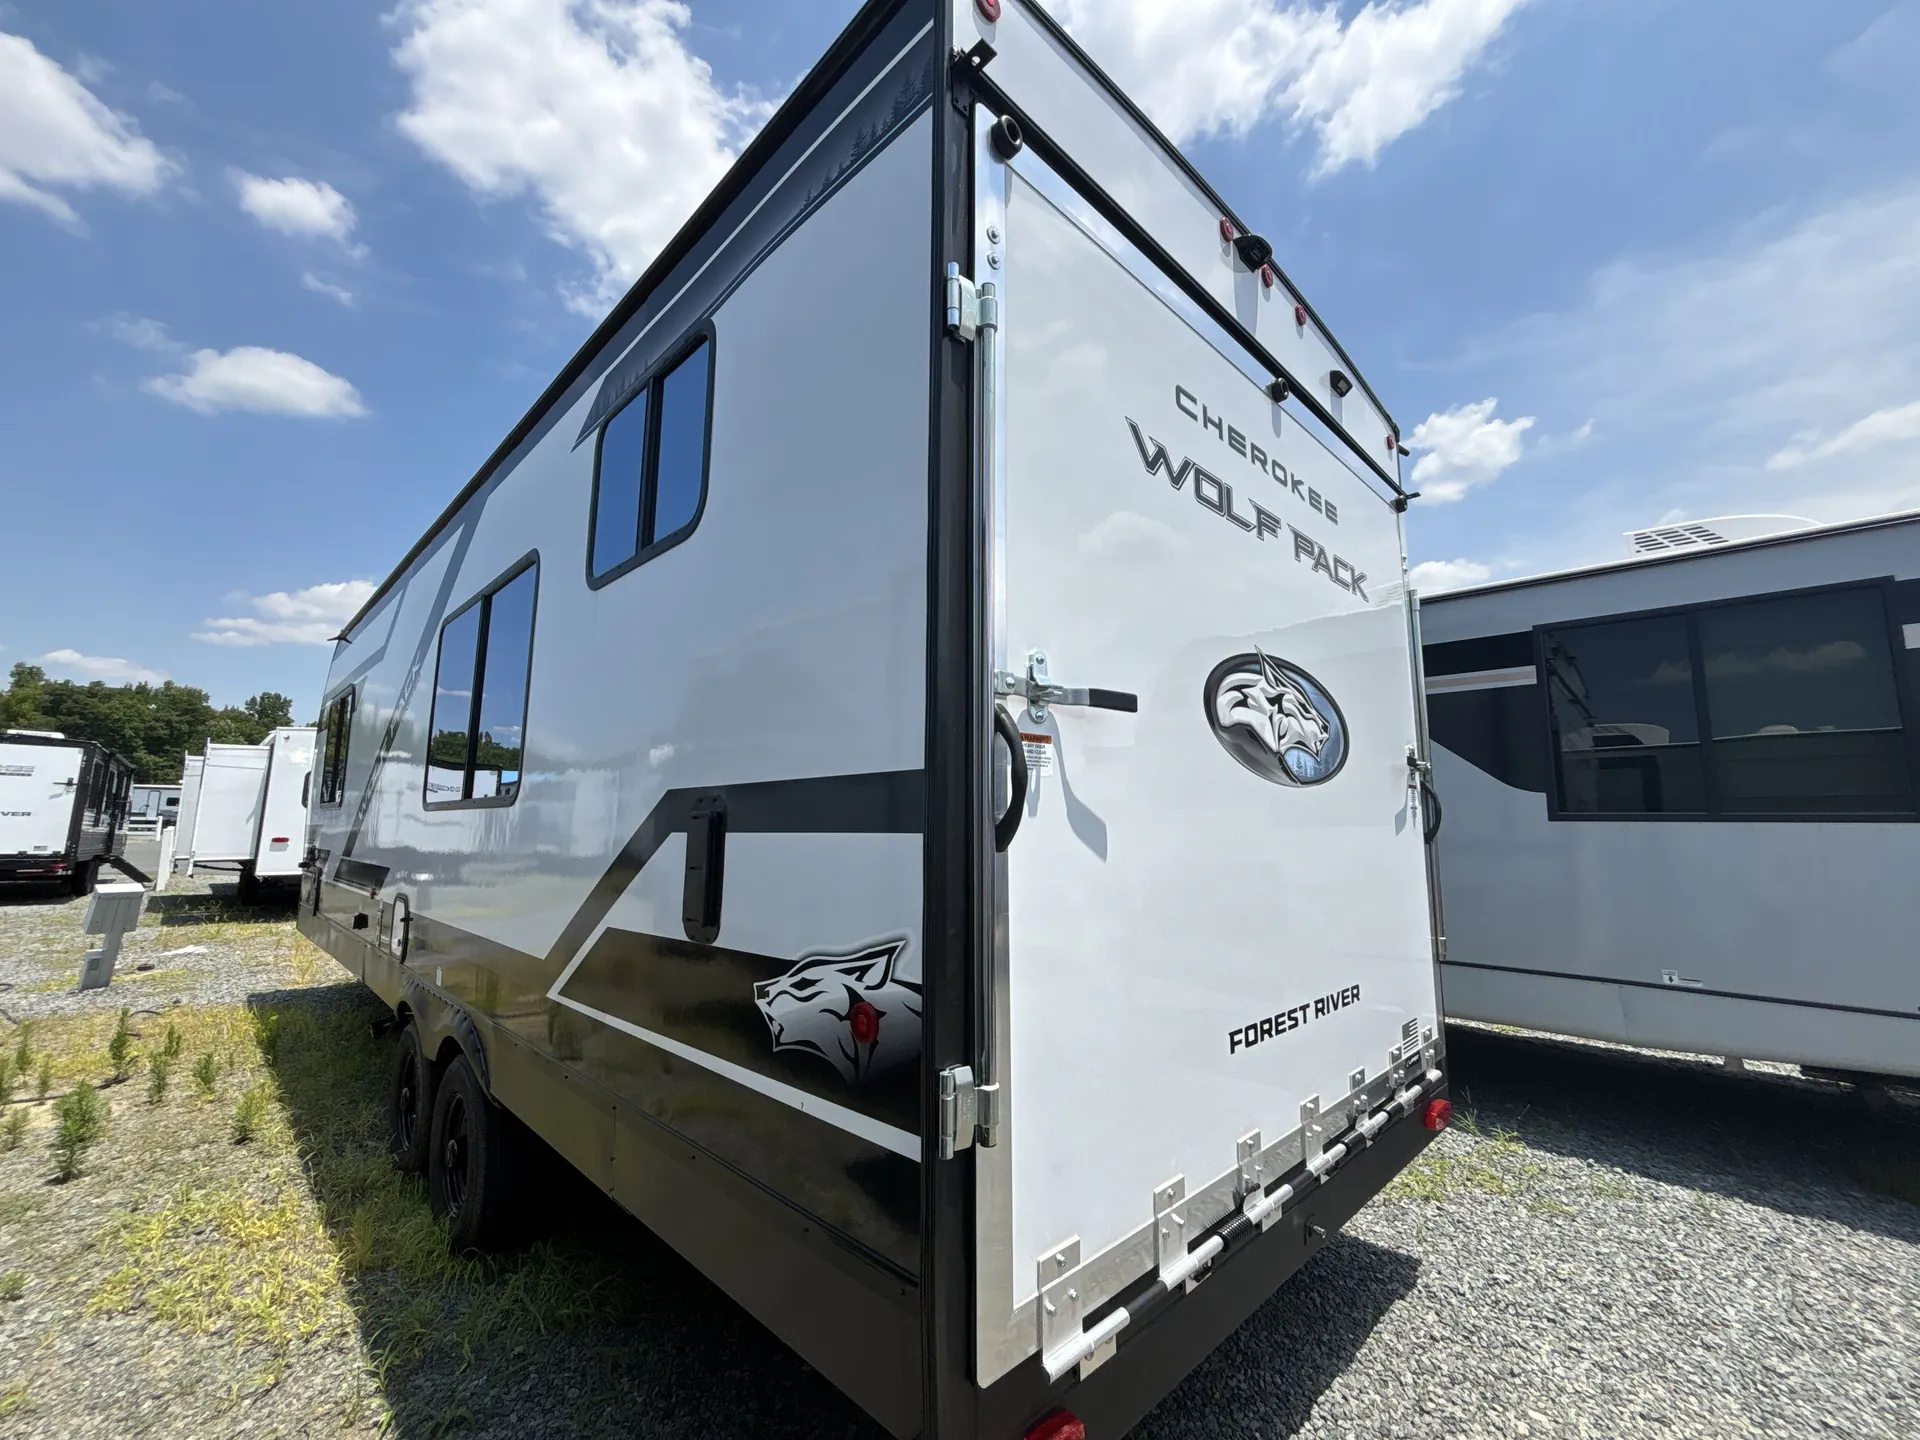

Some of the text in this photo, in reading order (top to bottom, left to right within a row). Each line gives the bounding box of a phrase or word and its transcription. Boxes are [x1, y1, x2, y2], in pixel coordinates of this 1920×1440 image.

[1124, 415, 1369, 602] WOLF PACK
[1175, 384, 1338, 526] CHEROKEE
[1228, 984, 1361, 1055] FOREST RIVER
